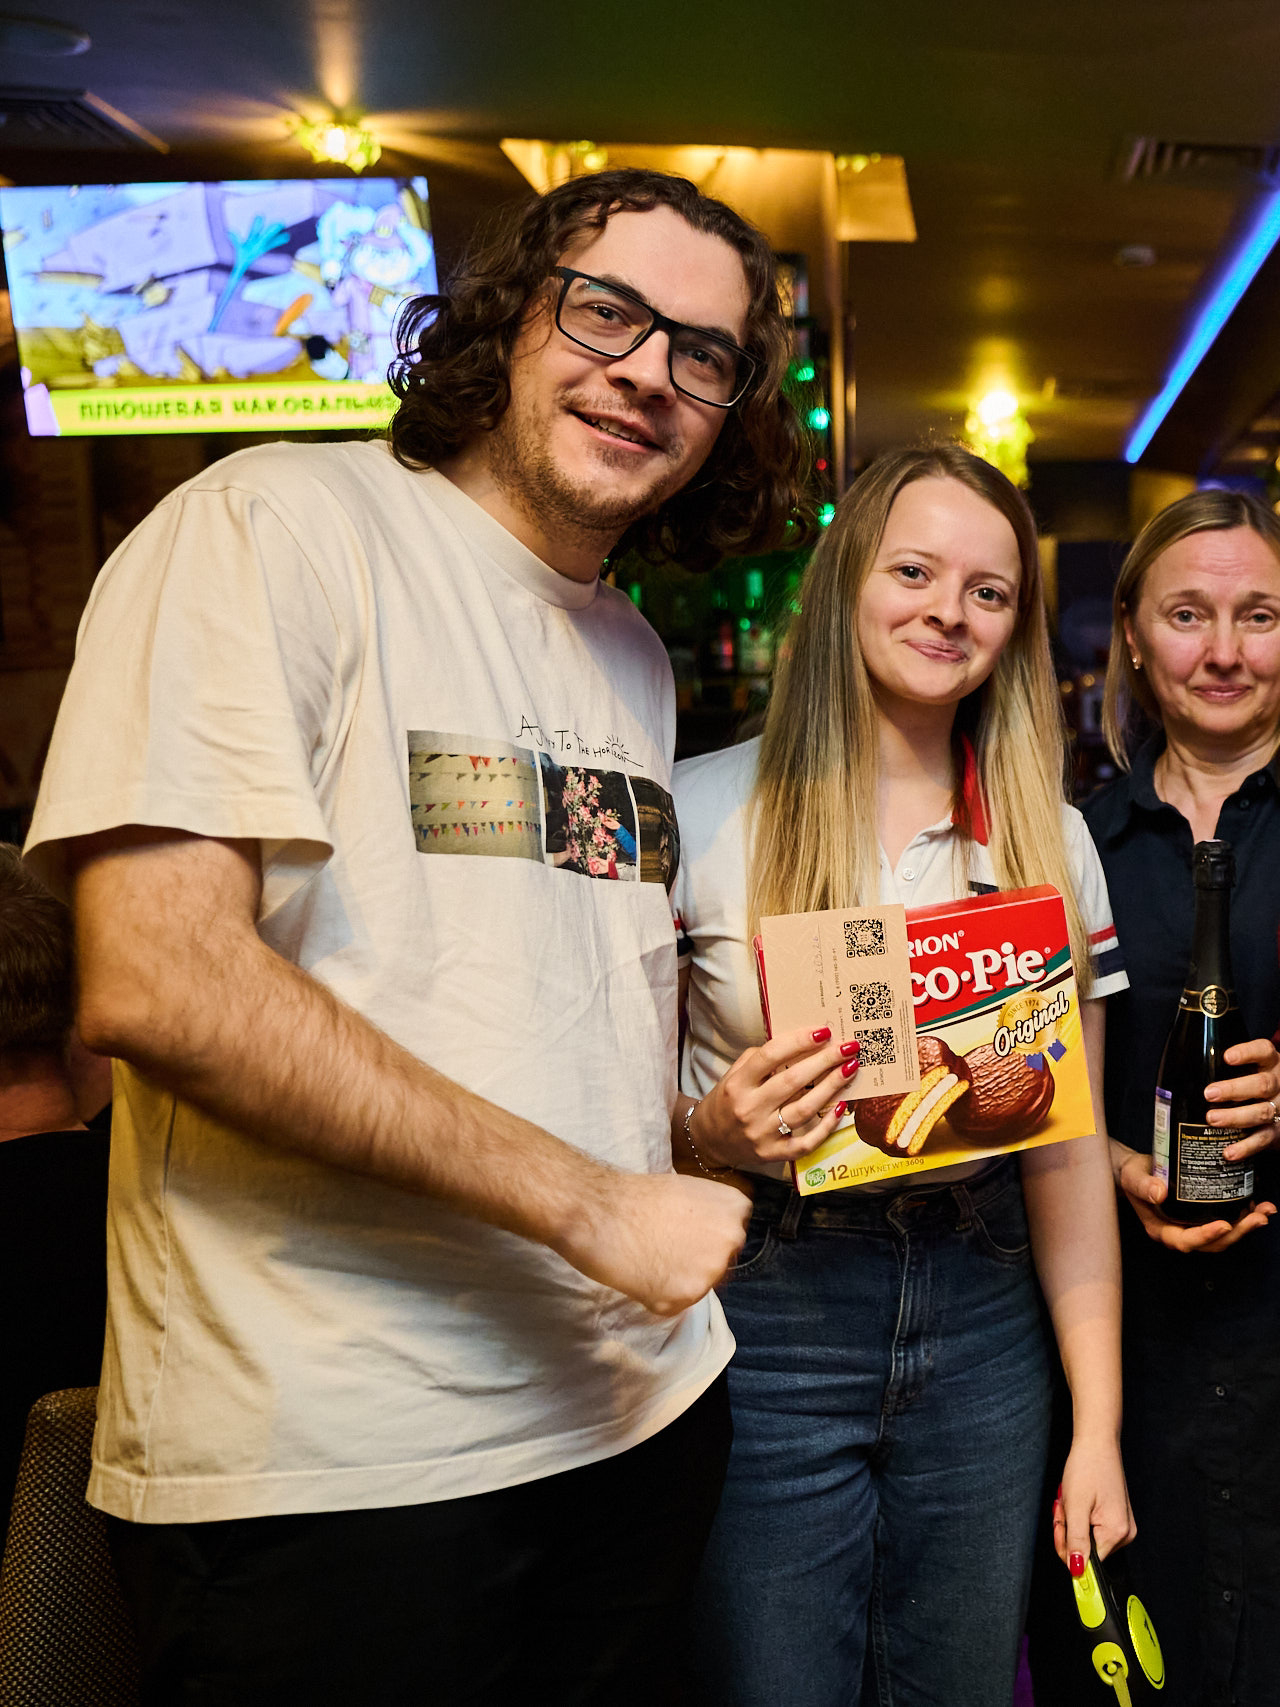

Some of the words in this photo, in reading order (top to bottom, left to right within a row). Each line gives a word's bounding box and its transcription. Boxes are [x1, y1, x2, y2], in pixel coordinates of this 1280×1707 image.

[80, 398, 223, 420] ПЛЮШЕВАЯ
[1007, 1003, 1025, 1018] SINCE
[993, 990, 1070, 1057] Original
[828, 1164, 849, 1181] 12
[850, 1165, 876, 1178] ШТУК
[876, 1163, 891, 1172] NET
[892, 1161, 904, 1170] WT
[905, 1158, 925, 1167] 360g
